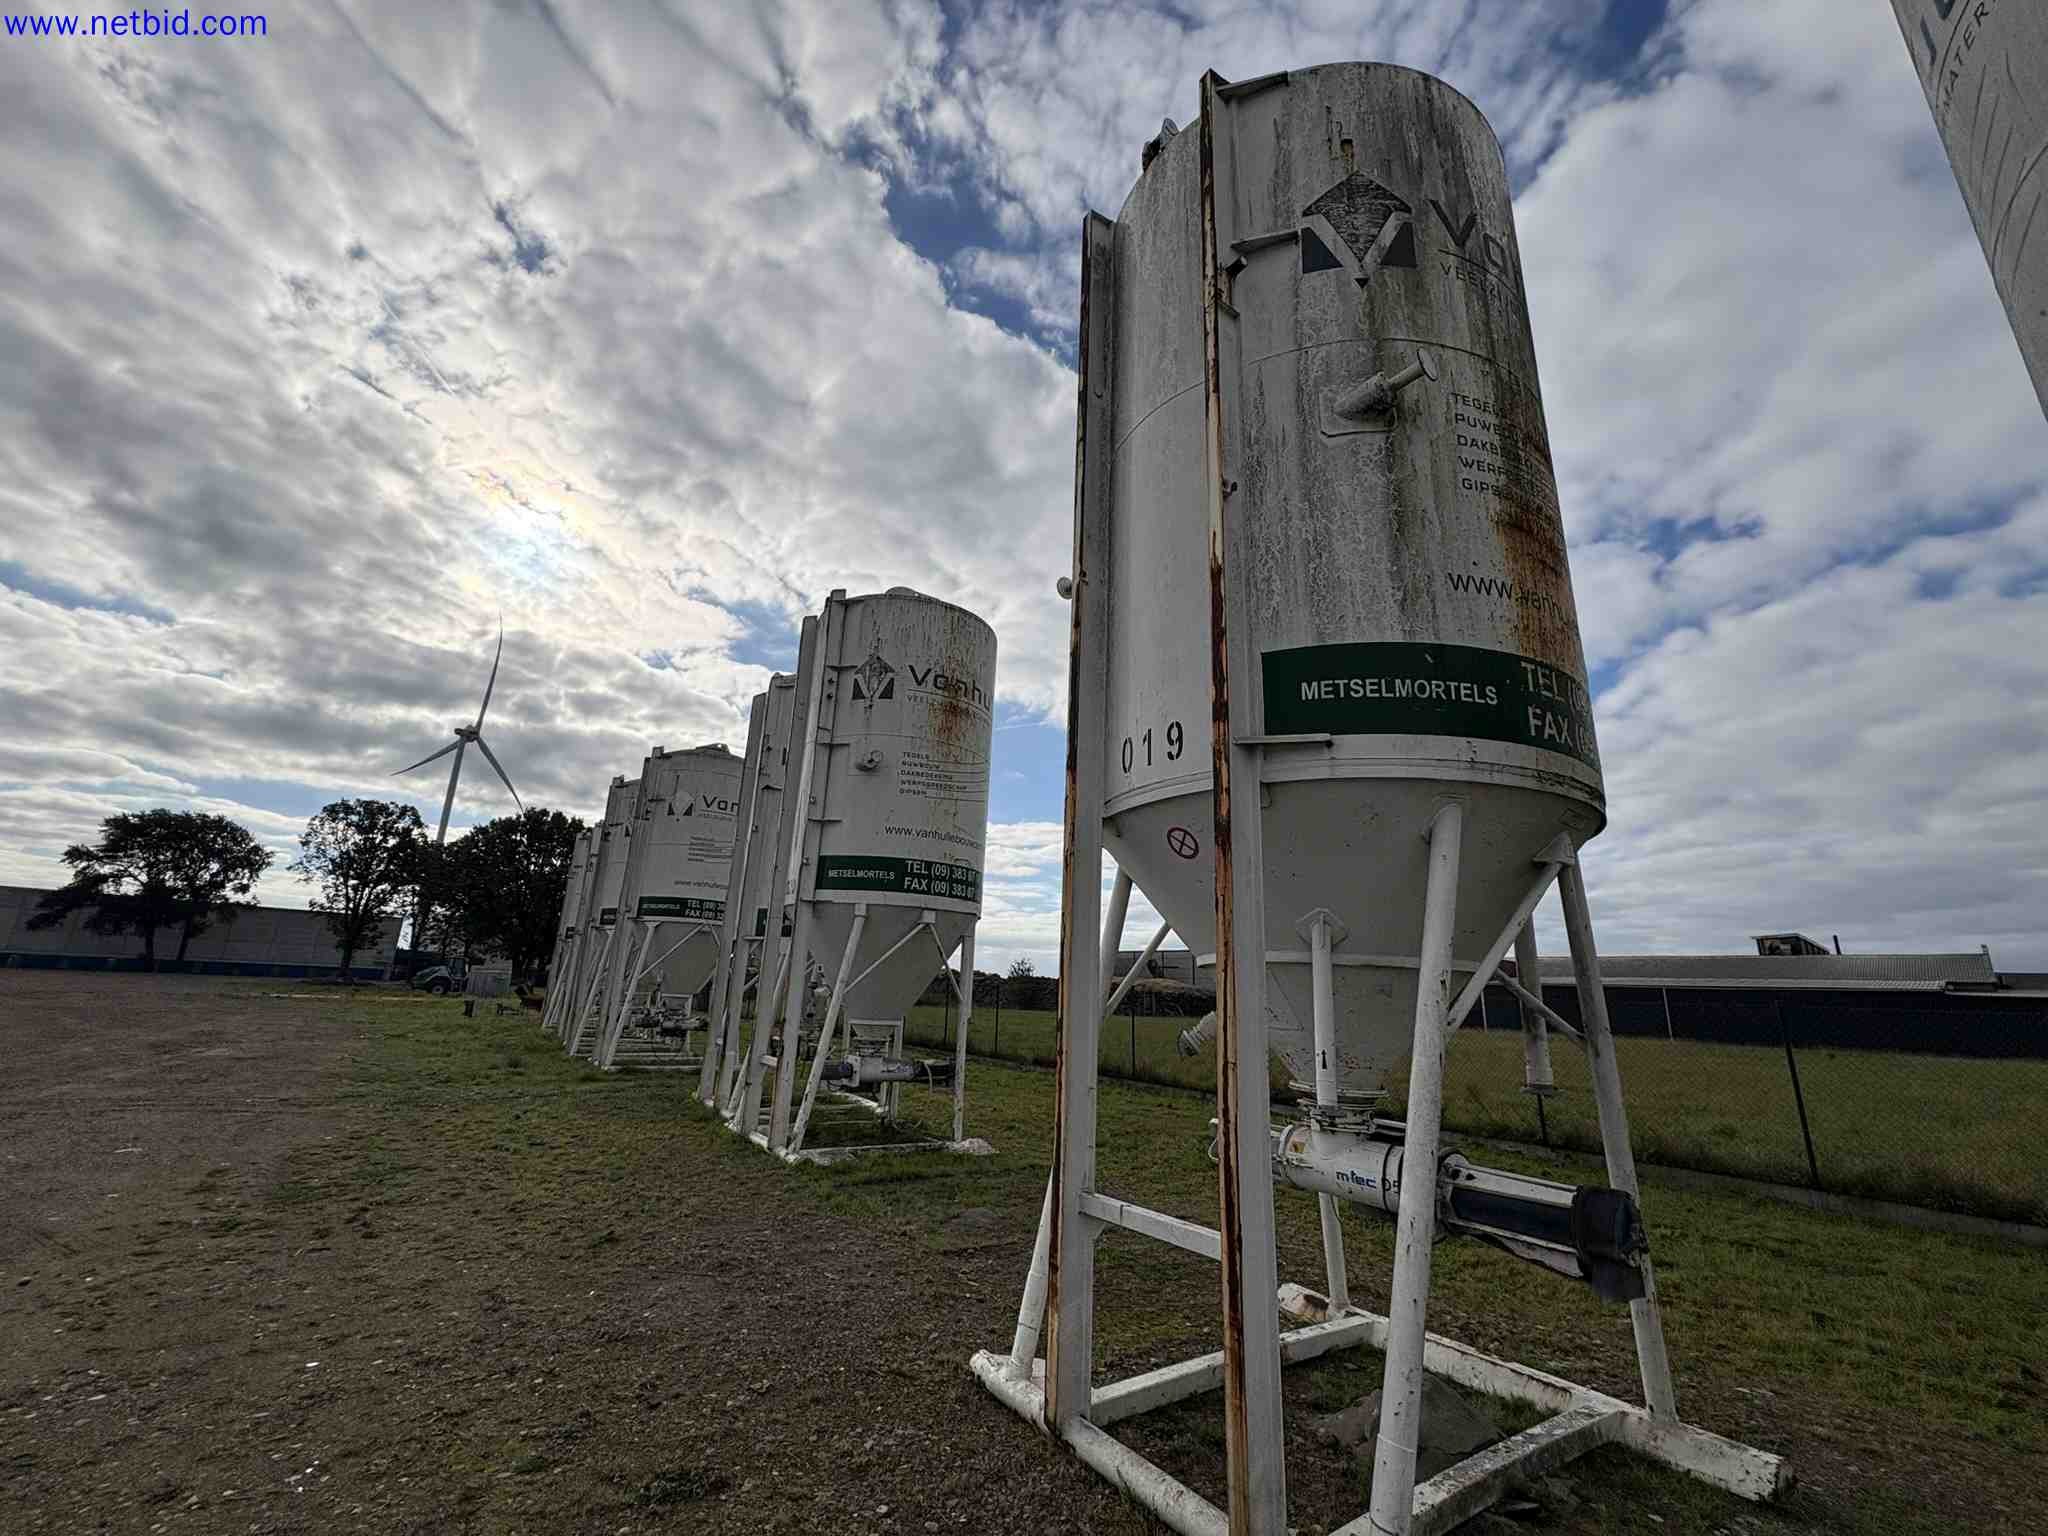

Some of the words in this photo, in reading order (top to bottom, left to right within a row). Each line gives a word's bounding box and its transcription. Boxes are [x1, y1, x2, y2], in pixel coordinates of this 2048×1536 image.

[1300, 677, 1498, 706] METSELMORTELS
[1519, 660, 1566, 703] TEL
[1122, 721, 1184, 774] 019
[1527, 703, 1573, 748] FAX
[828, 868, 895, 880] METSELMORTELS
[905, 860, 929, 874] TEL
[931, 863, 950, 880] (09)
[904, 876, 928, 891] FAX
[930, 880, 950, 897] (09)
